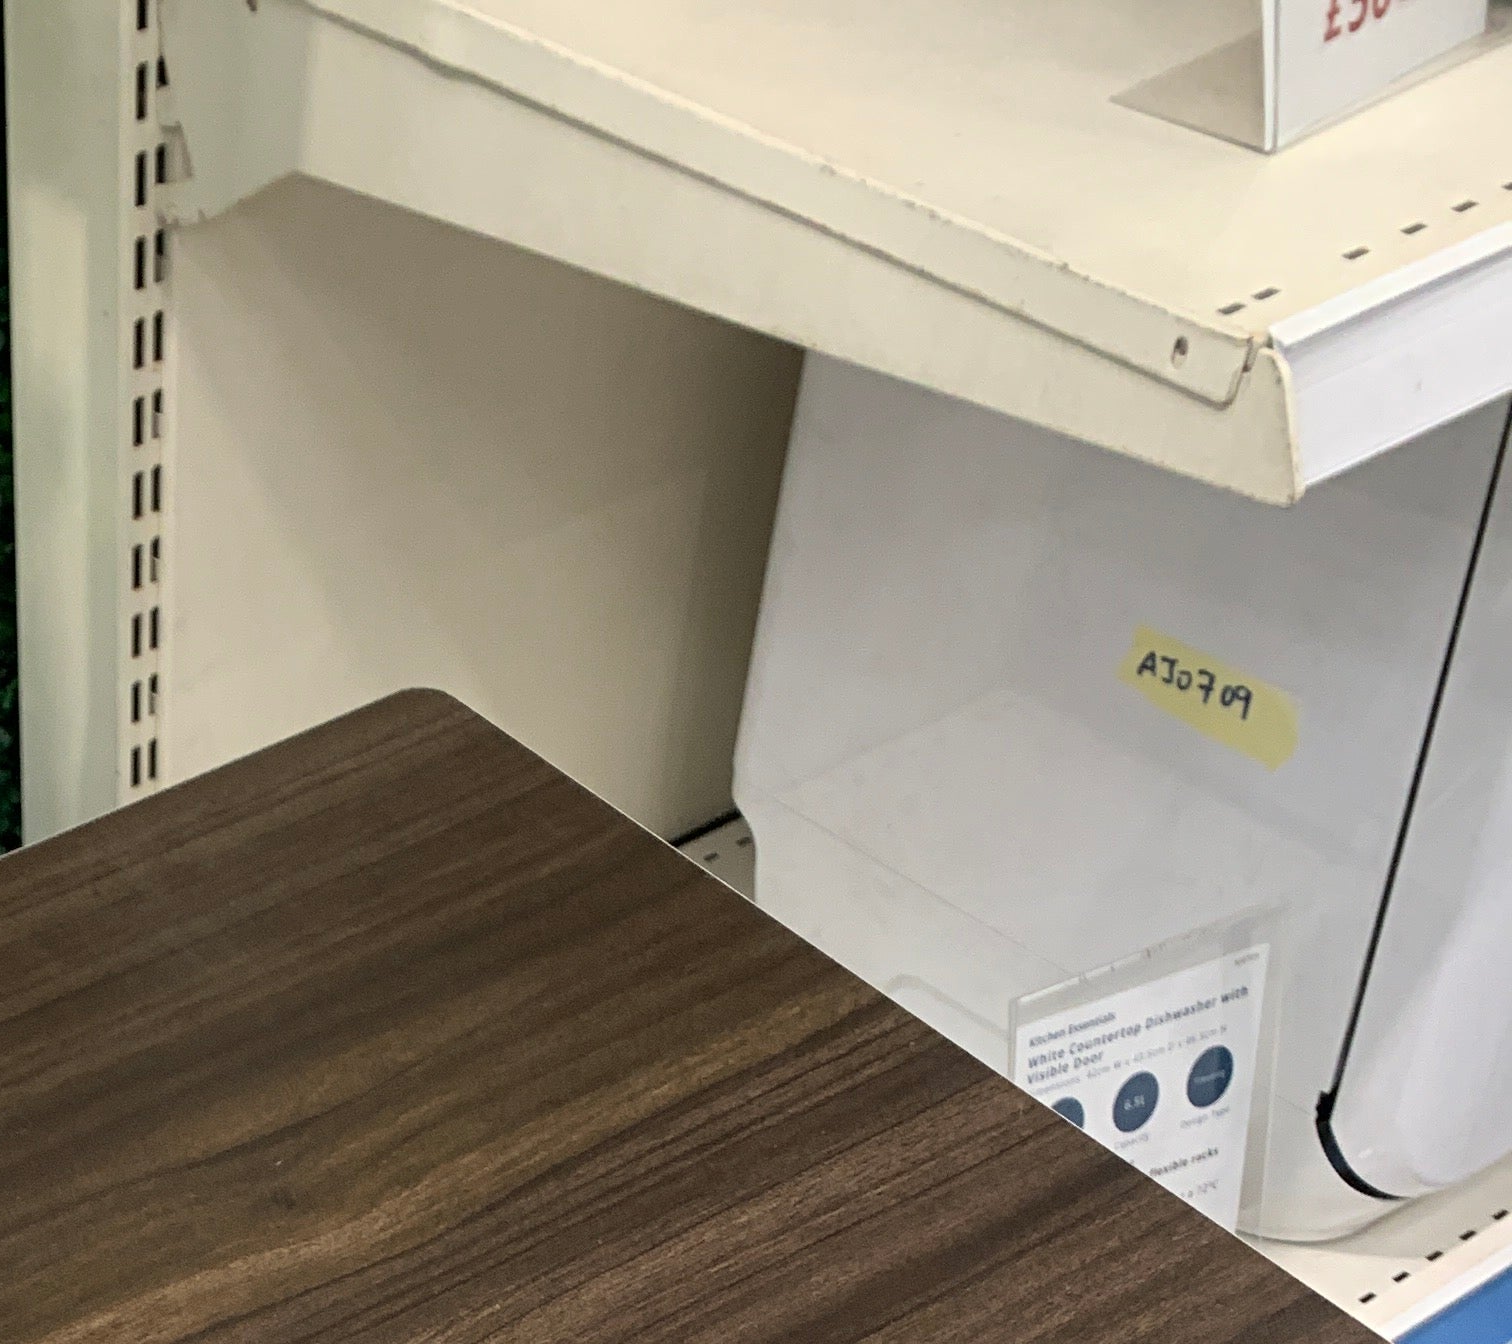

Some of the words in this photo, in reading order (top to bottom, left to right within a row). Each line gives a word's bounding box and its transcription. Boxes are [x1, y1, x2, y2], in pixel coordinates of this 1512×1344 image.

[1028, 1048, 1065, 1069] White
[1069, 1023, 1141, 1055] Countertop
[1145, 997, 1217, 1030] Dishwasher
[1220, 985, 1248, 1003] with
[1027, 1062, 1069, 1085] Visible
[1073, 1050, 1103, 1069] Door
